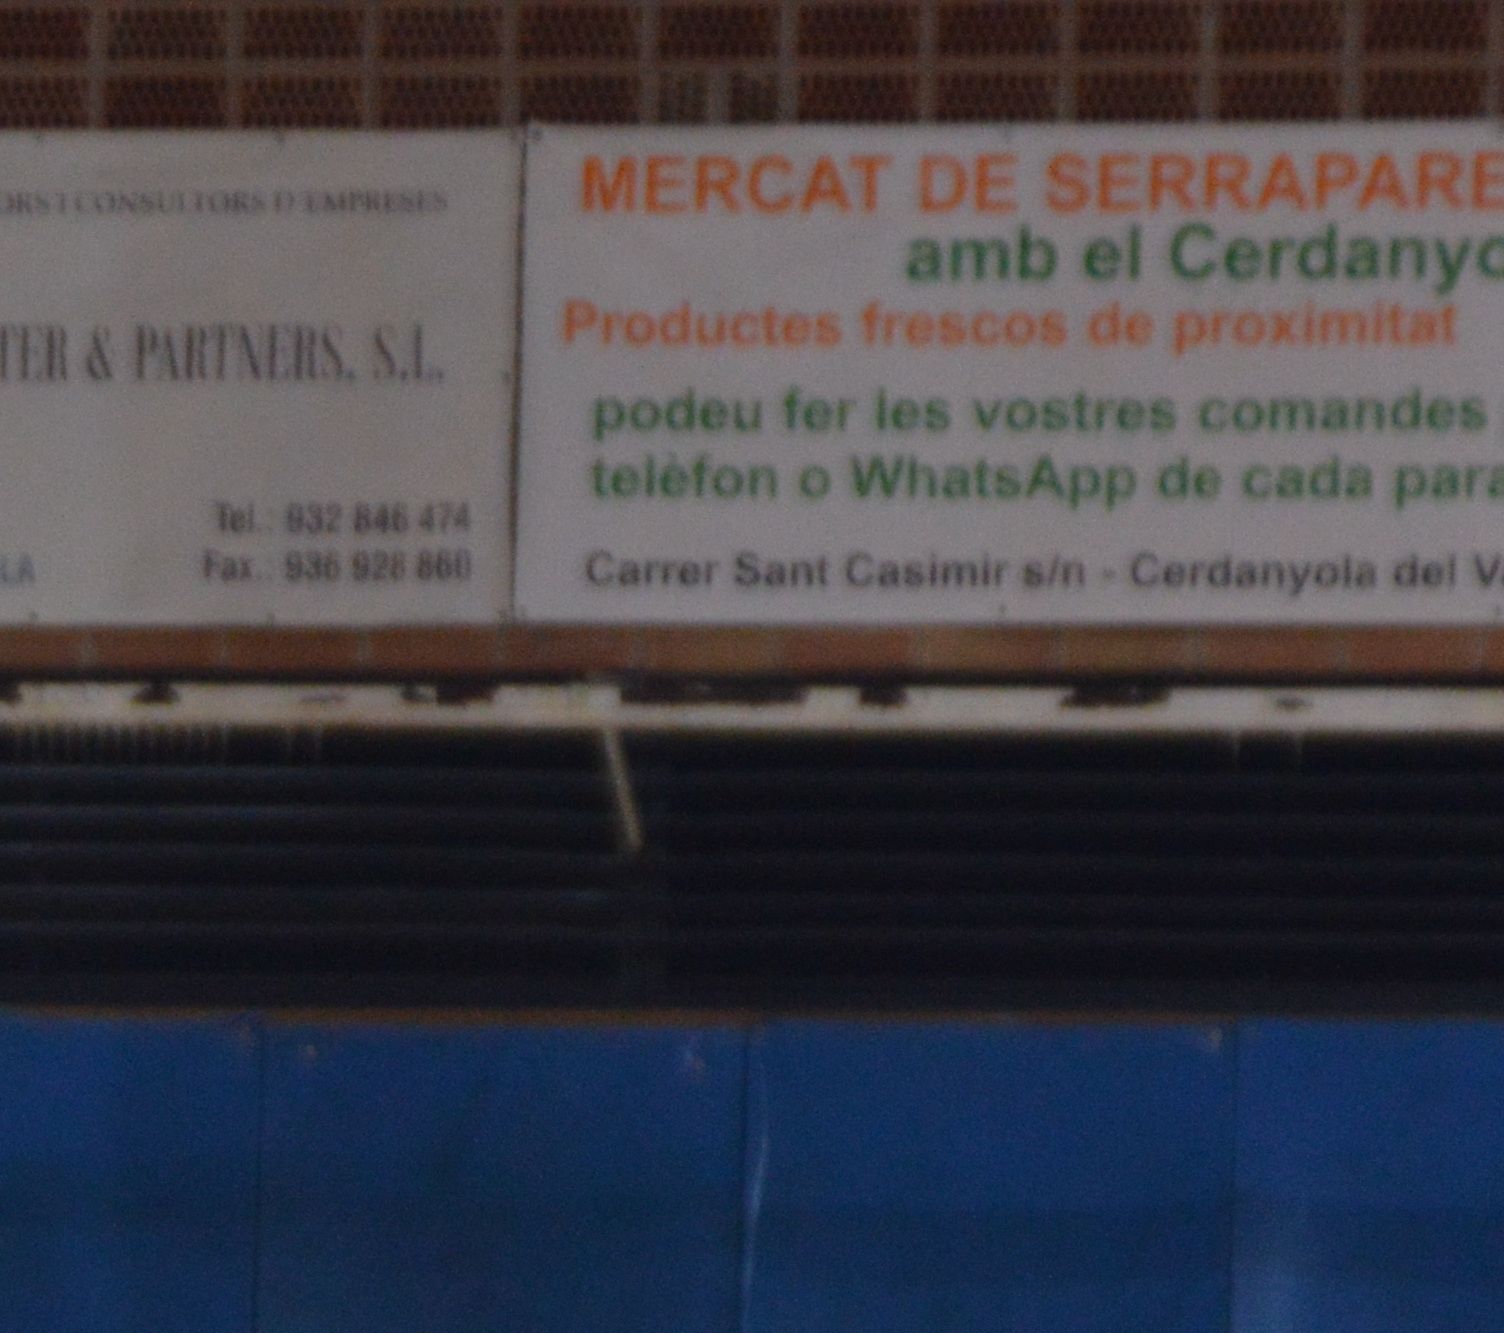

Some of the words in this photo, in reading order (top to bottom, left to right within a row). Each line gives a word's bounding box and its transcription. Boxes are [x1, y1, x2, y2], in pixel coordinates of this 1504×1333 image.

[580, 152, 893, 215] MERCAT
[918, 153, 1020, 214] DE
[906, 224, 1058, 283] amb
[1084, 225, 1141, 281] el
[88, 325, 113, 381] &
[135, 325, 356, 383] PARTNERS,
[562, 299, 842, 347] Productes
[860, 301, 1068, 347] frescos
[1087, 302, 1154, 347] de
[1173, 302, 1458, 357] proximitat
[592, 386, 762, 441] podeu
[785, 385, 854, 432] fer
[875, 386, 952, 432] les
[975, 390, 1176, 433] vostres
[1198, 386, 1489, 433] comandes
[591, 451, 779, 500] telèfon
[797, 464, 832, 500] o
[849, 452, 1138, 511] WhatsApp
[1157, 457, 1223, 500] de
[1241, 455, 1374, 500] cada
[584, 549, 719, 589] Carrer
[733, 549, 829, 589] Sant
[844, 550, 1008, 589] Casimir
[1021, 551, 1086, 589] s/n
[1130, 551, 1378, 598] Cerdanyola
[1393, 553, 1457, 589] del
